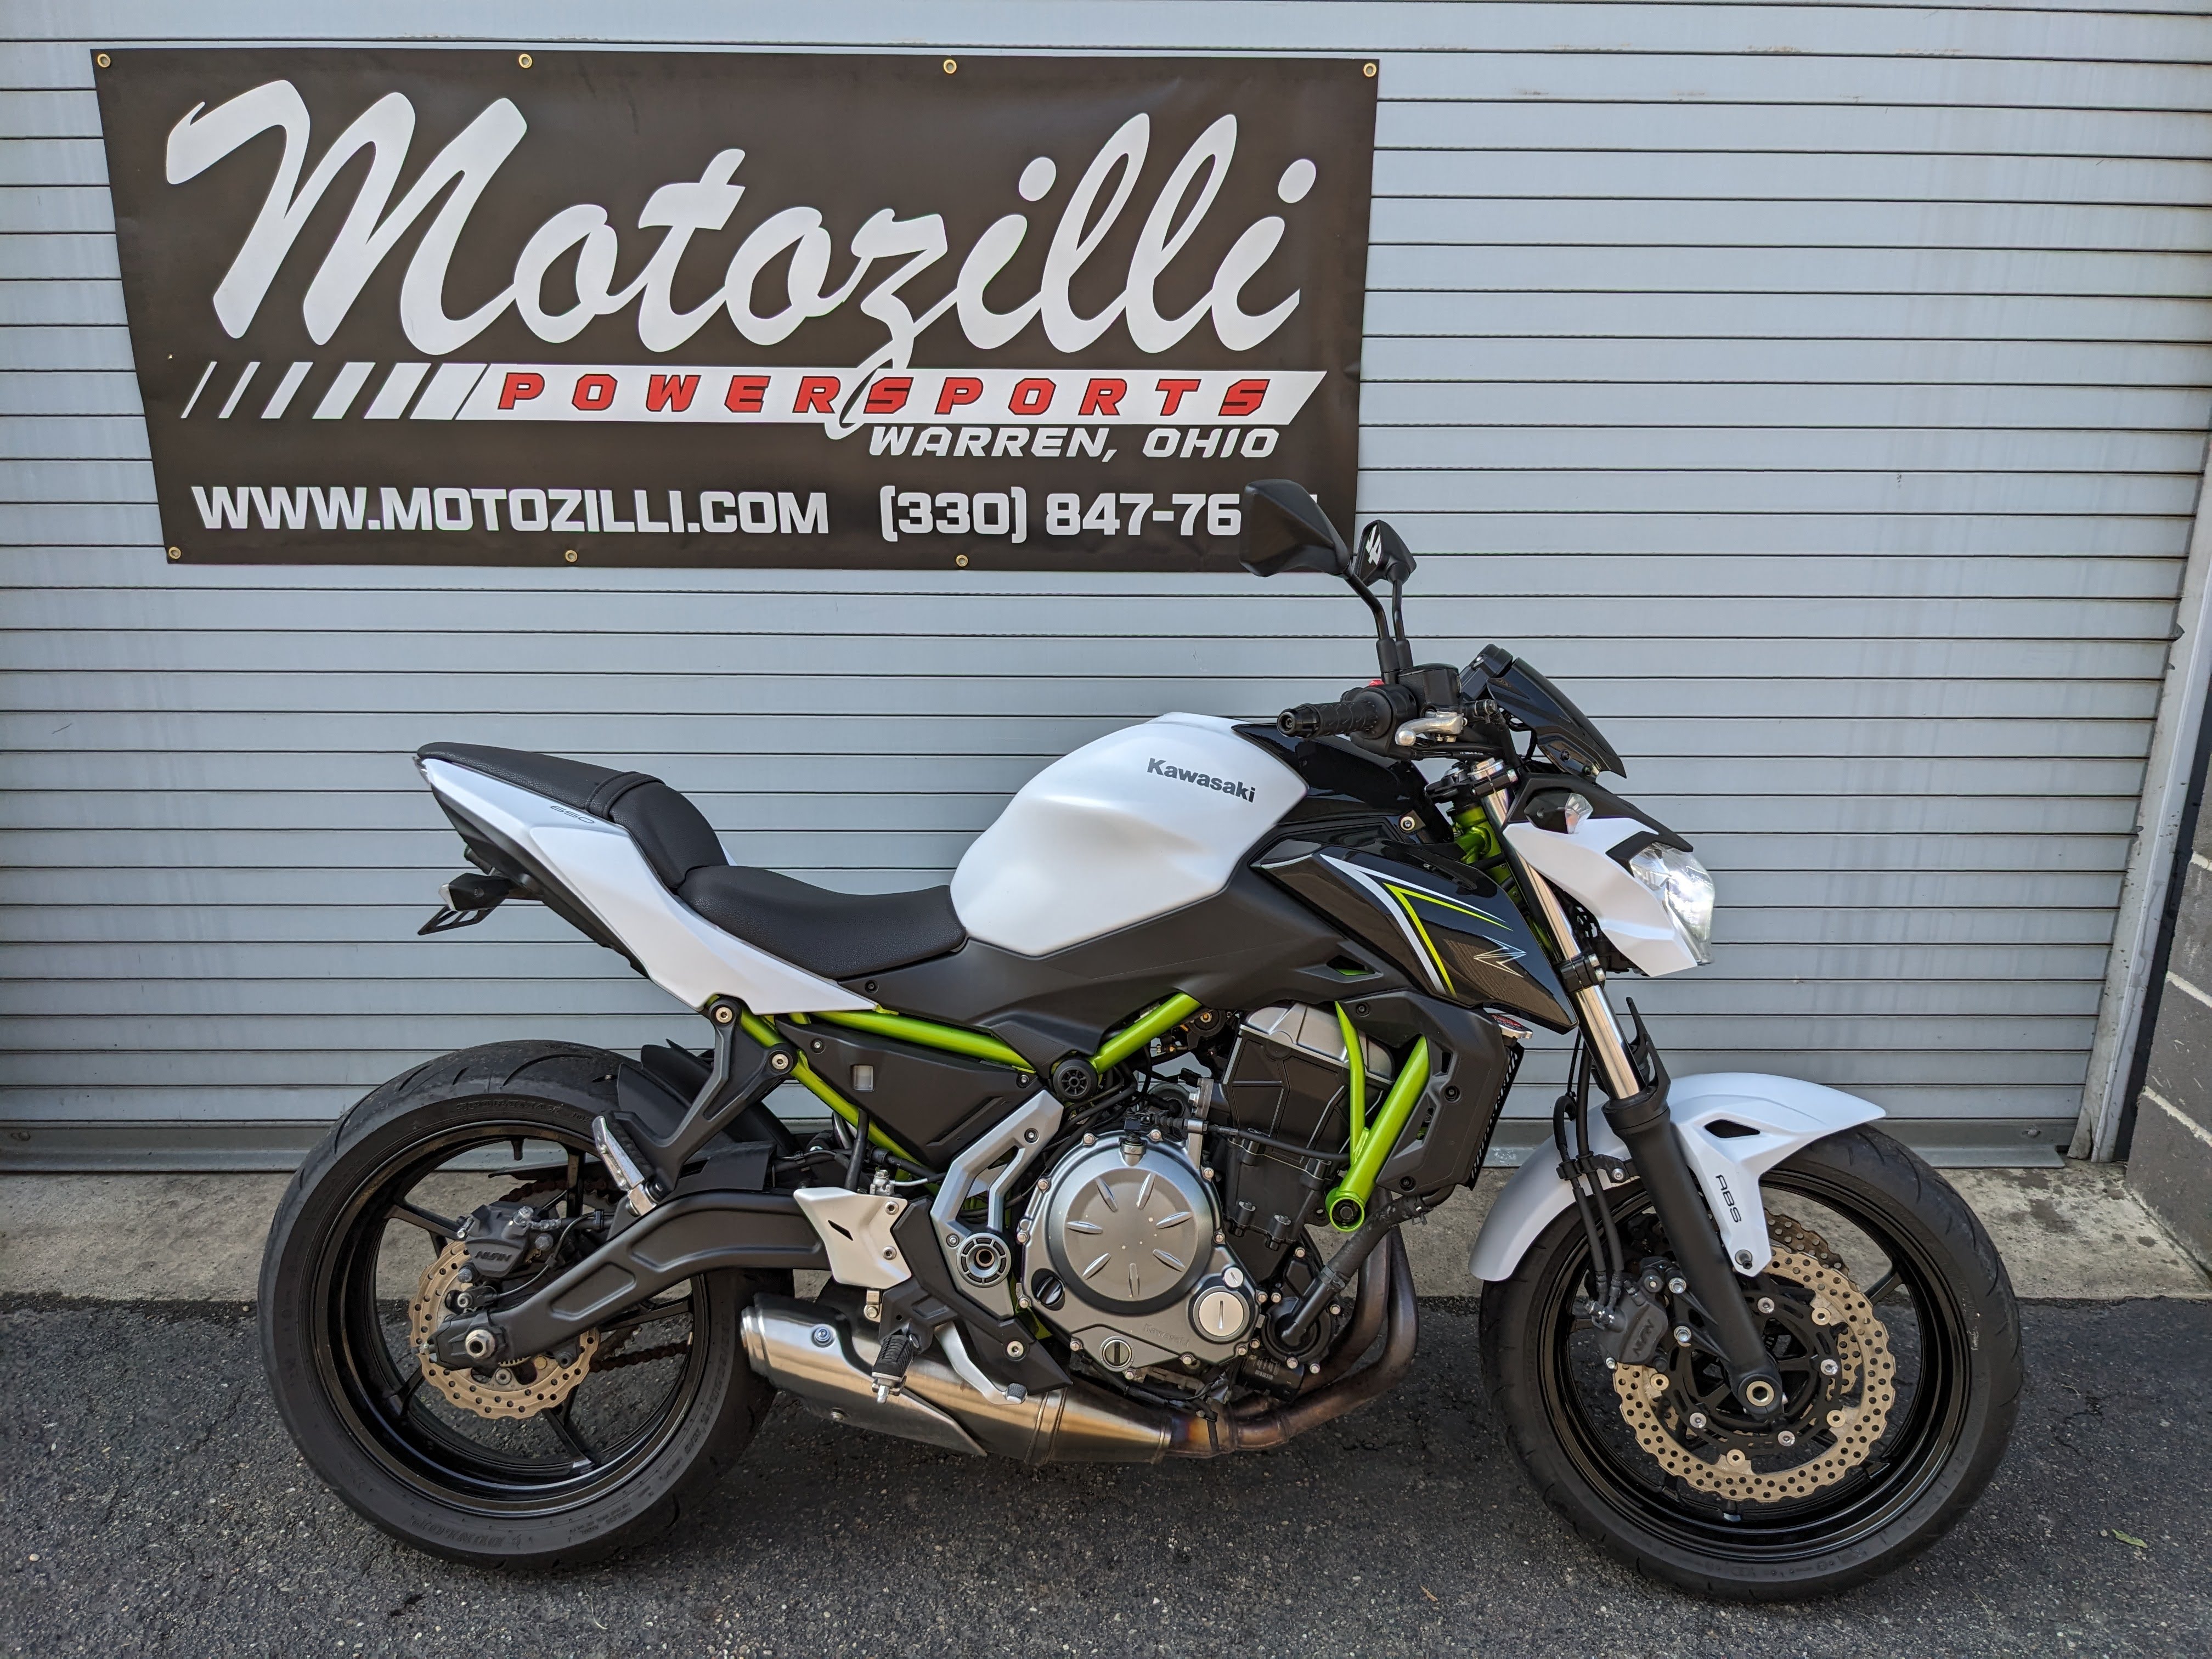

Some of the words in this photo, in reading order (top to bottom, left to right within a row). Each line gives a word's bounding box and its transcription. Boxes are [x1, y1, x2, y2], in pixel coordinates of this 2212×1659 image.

[166, 80, 1317, 441] Motozilli
[498, 373, 1271, 416] POWERSPORTS
[869, 426, 1117, 462] WARREN,
[1142, 428, 1279, 459] OHIO
[191, 486, 830, 534] WWW.MOTOZILLI.COM
[880, 486, 1027, 543] (330)
[1046, 493, 1318, 537] 847-76
[1147, 758, 1256, 803] Kawasaki
[550, 805, 595, 823] 650
[1715, 1174, 1742, 1223] ABS
